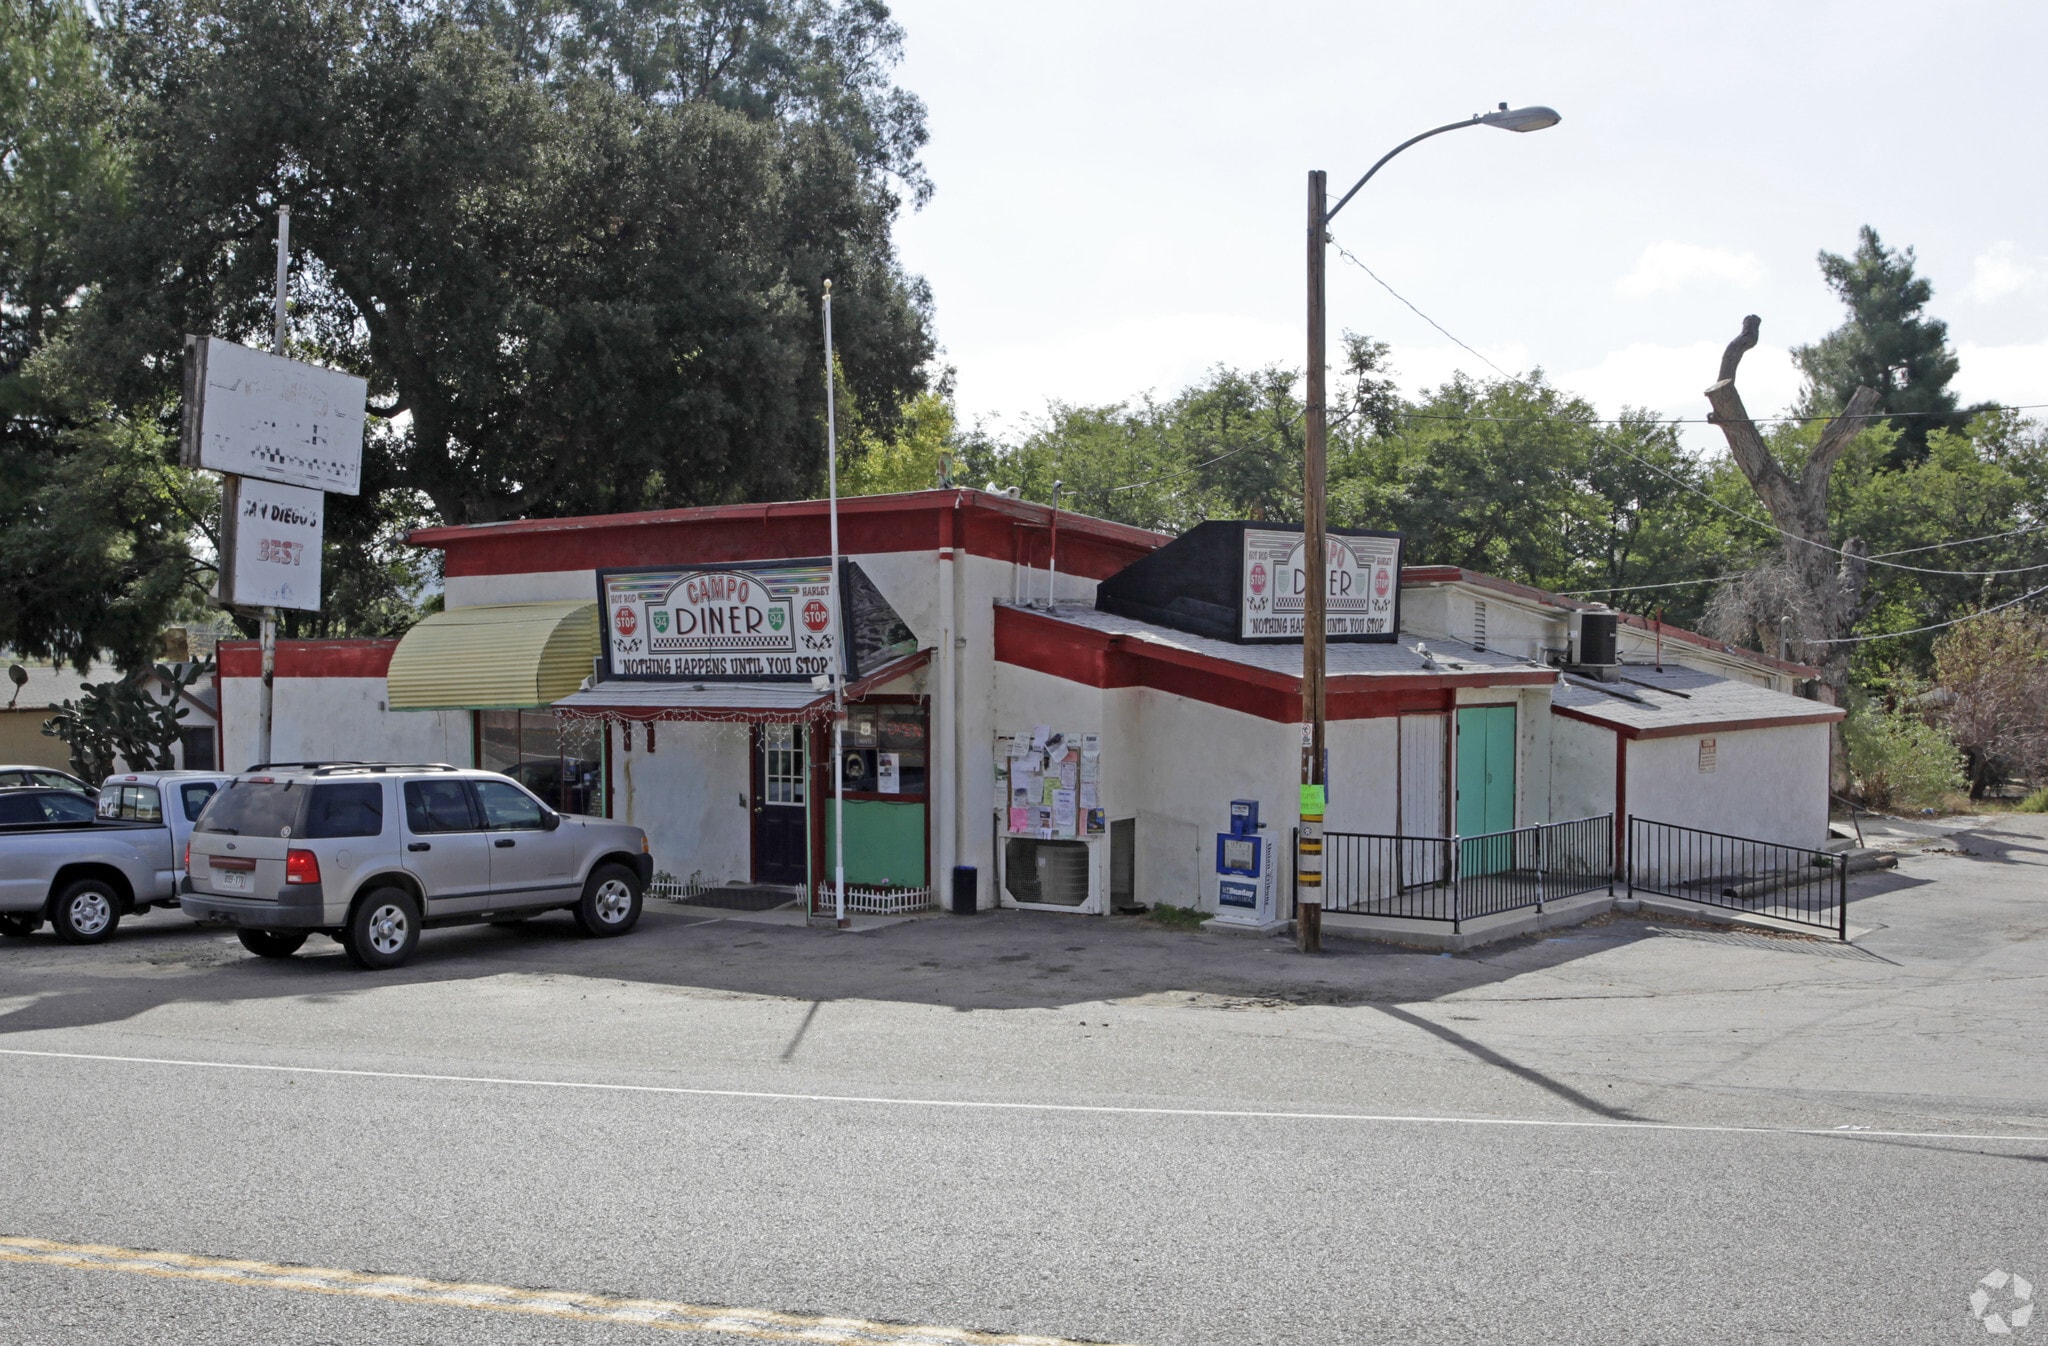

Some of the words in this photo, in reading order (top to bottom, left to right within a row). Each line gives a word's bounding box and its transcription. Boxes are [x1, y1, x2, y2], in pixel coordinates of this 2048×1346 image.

[256, 538, 304, 566] BEST
[1250, 574, 1266, 585] STOP
[1294, 568, 1352, 596] DER
[1375, 577, 1389, 588] STOP
[688, 576, 749, 605] CAMPO
[802, 586, 829, 597] HARLEY
[610, 594, 622, 604] HOT
[624, 594, 637, 603] ROD
[621, 609, 629, 617] PIT
[810, 603, 819, 611] PIT
[616, 616, 635, 628] STOP
[655, 615, 667, 629] 94
[676, 605, 763, 635] DINER
[769, 613, 782, 626] 94
[804, 611, 827, 623] STOP
[1327, 618, 1348, 633] UNTIL
[1349, 617, 1364, 633] YOU
[675, 656, 727, 675] HAPPENS
[730, 656, 764, 674] UNTIL
[766, 657, 791, 674] YOU
